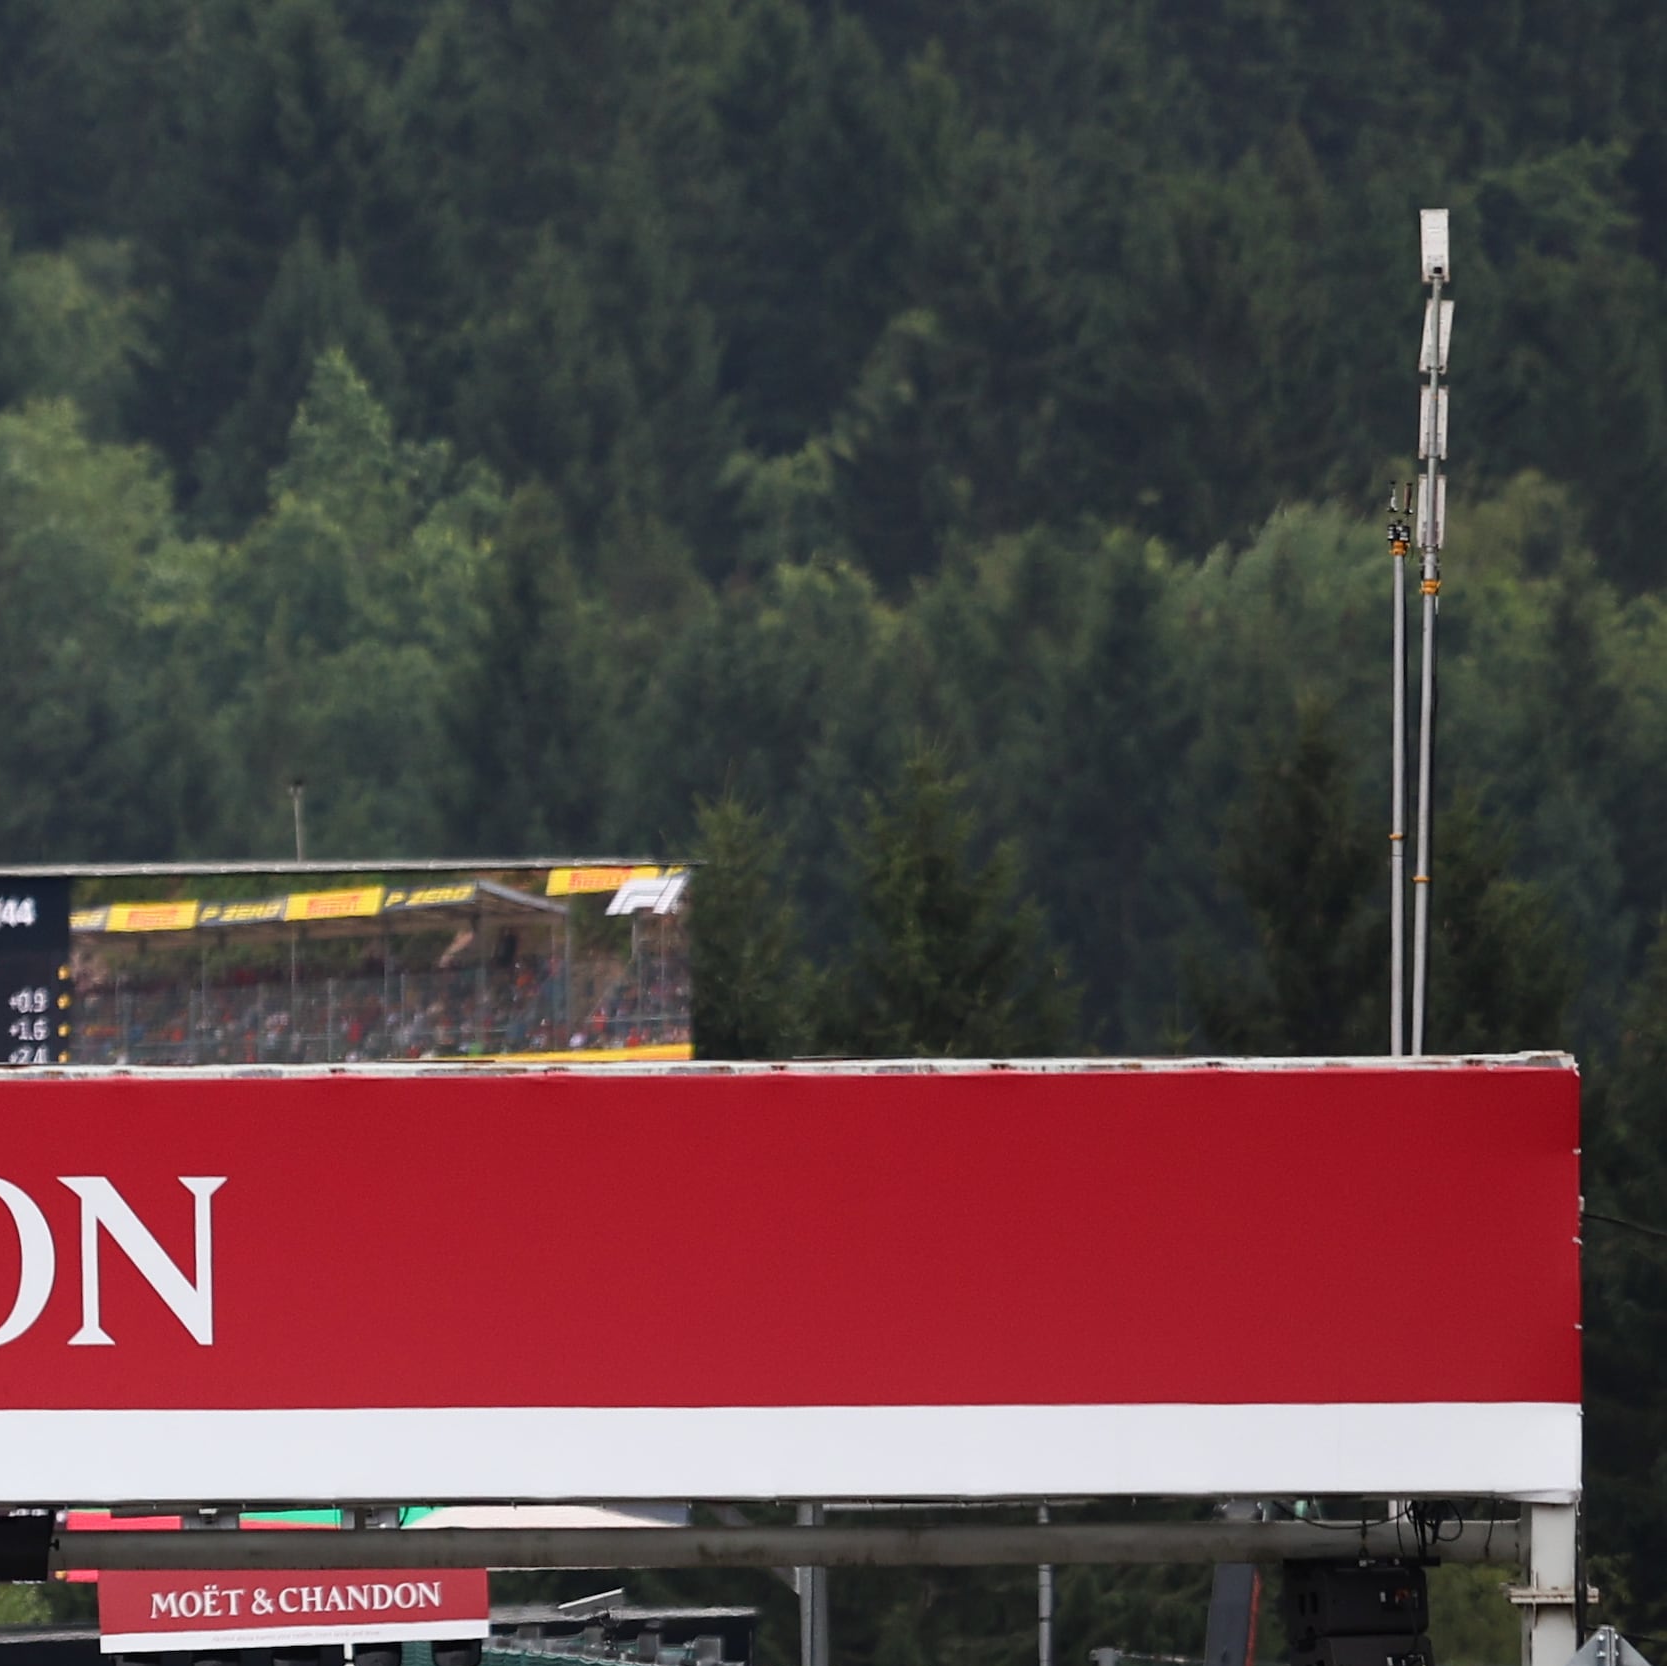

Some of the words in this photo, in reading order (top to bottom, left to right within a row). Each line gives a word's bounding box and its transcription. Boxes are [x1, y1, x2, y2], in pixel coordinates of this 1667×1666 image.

[8, 988, 48, 1014] +0.9
[8, 1017, 49, 1041] +1.6
[150, 1585, 244, 1619] MOËT
[251, 1587, 275, 1614] &
[279, 1581, 442, 1613] CHANDON
